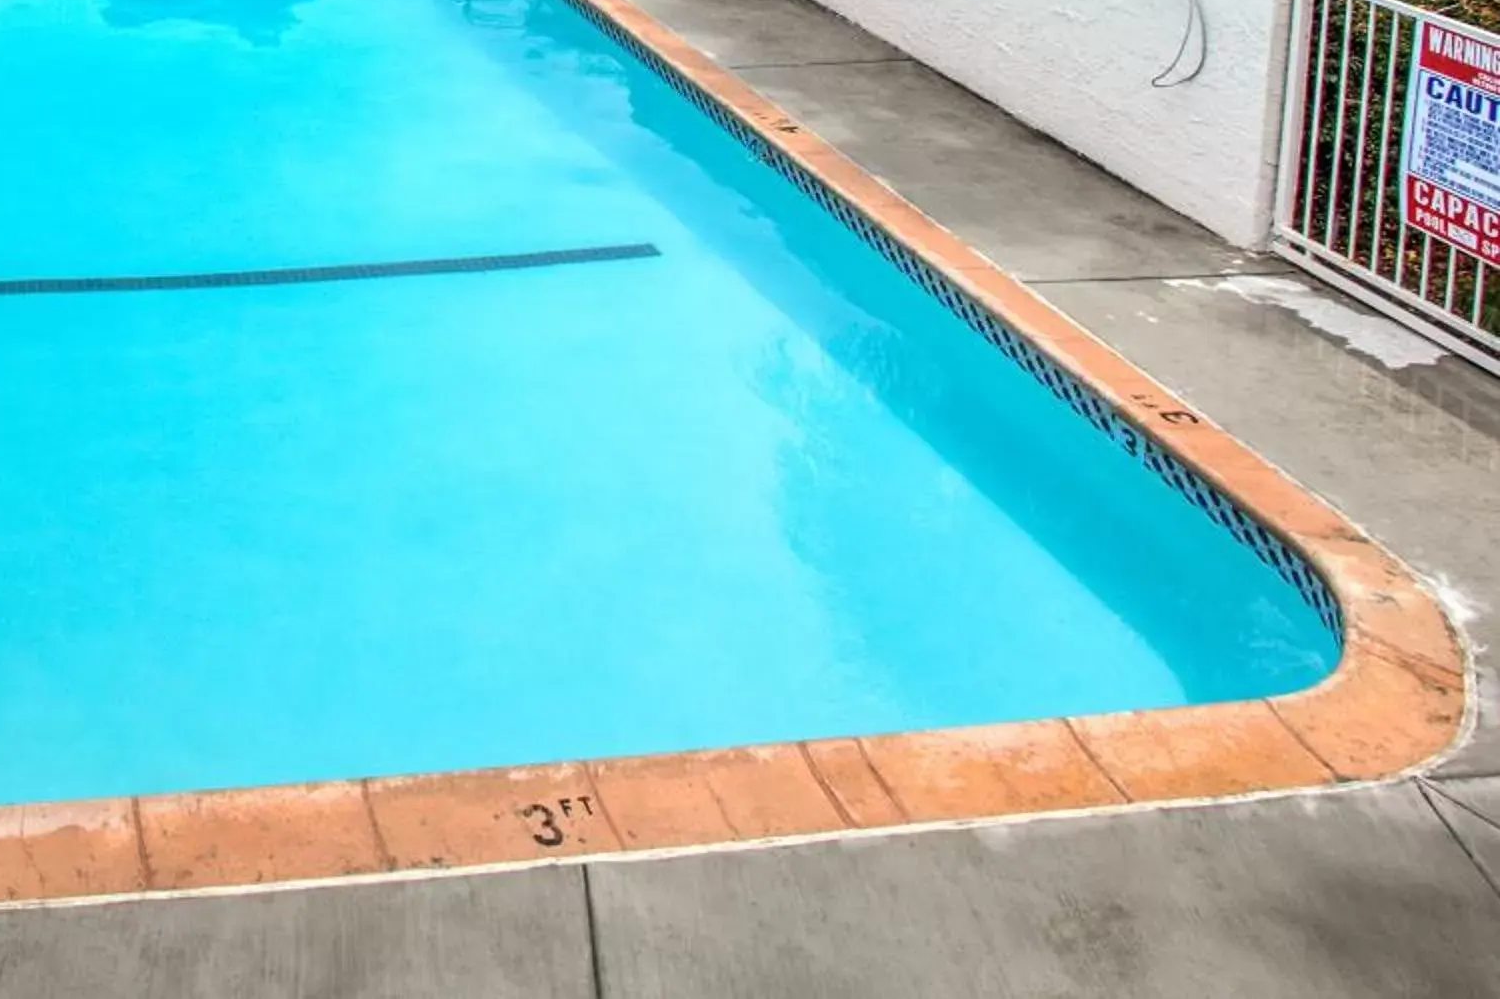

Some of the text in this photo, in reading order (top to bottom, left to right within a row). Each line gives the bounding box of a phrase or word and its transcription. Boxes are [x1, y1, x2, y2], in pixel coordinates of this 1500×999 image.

[1413, 180, 1500, 238] CAPAC
[1415, 206, 1447, 236] POOL
[521, 796, 594, 847] 3 FT
